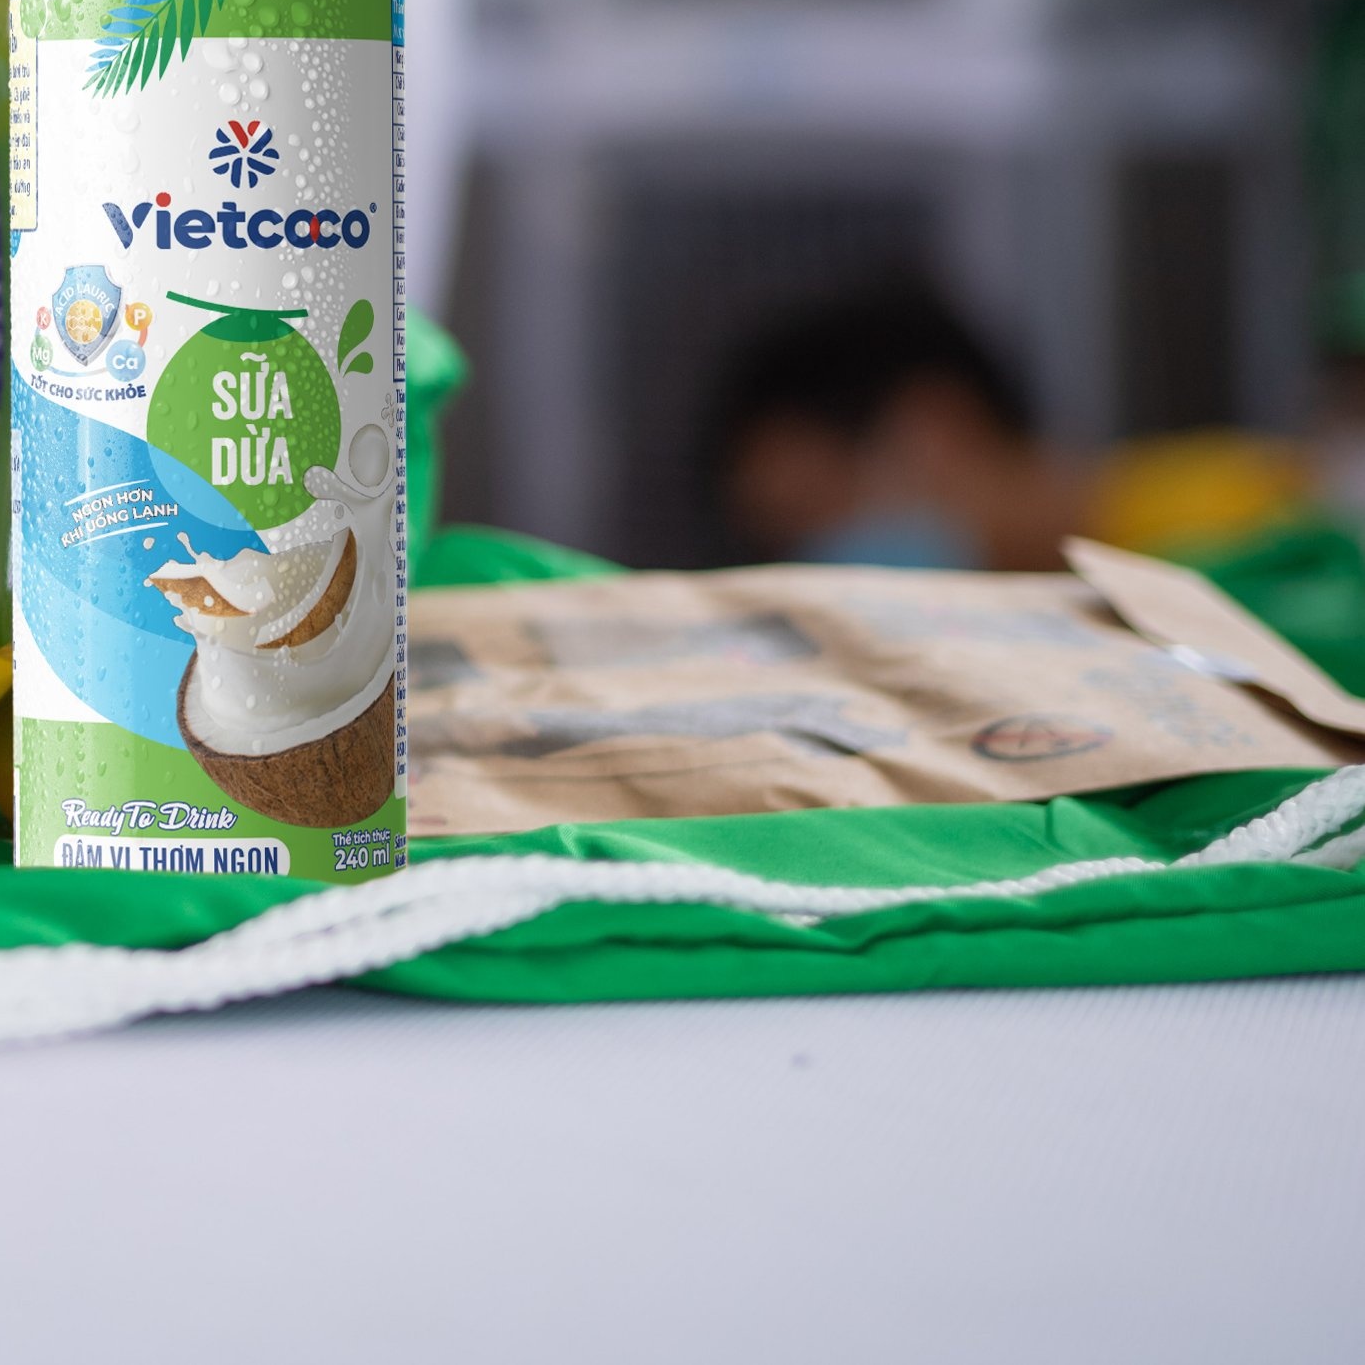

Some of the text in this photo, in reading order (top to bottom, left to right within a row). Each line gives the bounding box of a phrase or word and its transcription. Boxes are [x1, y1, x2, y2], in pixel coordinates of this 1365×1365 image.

[102, 192, 370, 250] Vietcoco
[55, 283, 115, 318] ACID LAURIC
[133, 309, 147, 326] P
[40, 312, 48, 326] K
[33, 346, 51, 364] Mg
[112, 356, 139, 370] Ca
[30, 373, 147, 401] TỐT CHO SỨC KHỎE
[212, 351, 294, 420] SỮA
[212, 423, 294, 486] DỪA
[71, 488, 154, 523] NGON HƠN
[61, 502, 179, 549] KHI UỐNG LẠNH
[62, 798, 238, 835] Ready To Drink
[335, 842, 390, 871] 240 ml
